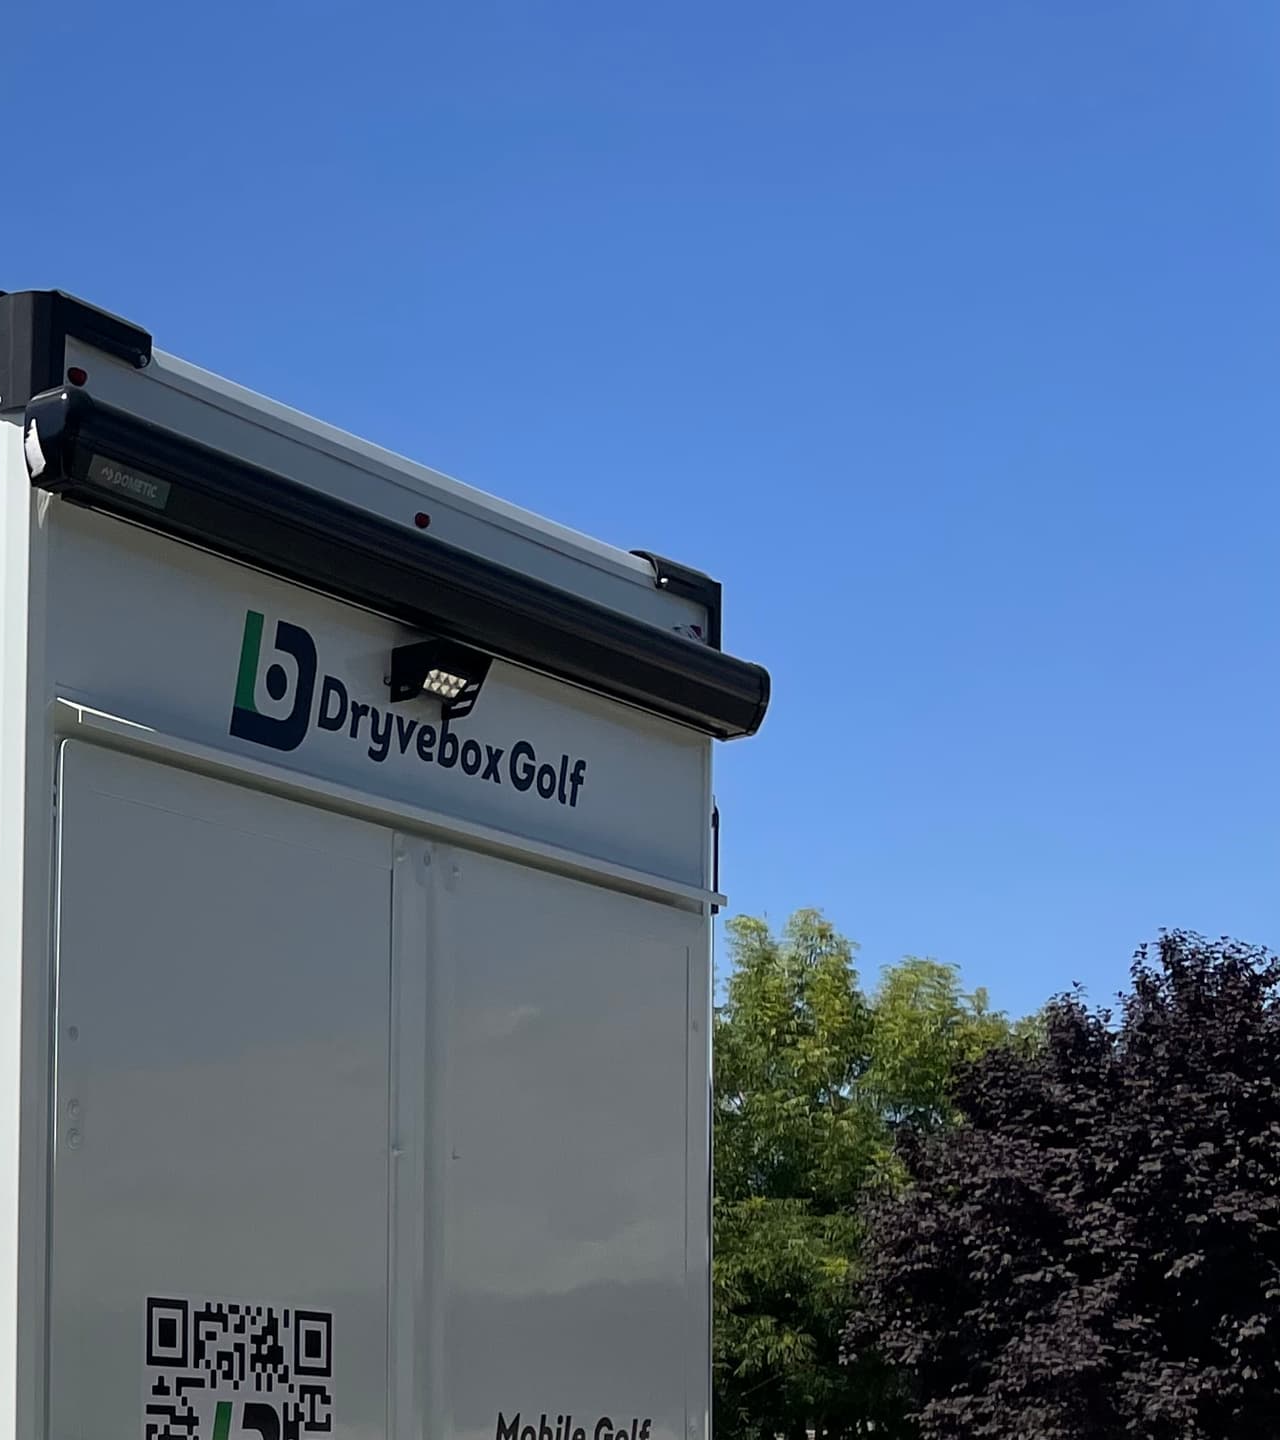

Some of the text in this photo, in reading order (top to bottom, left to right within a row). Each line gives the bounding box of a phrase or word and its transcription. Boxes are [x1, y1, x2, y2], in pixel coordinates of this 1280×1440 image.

[112, 471, 158, 498] DOMETIC
[317, 675, 586, 807] Dryvebox Golf
